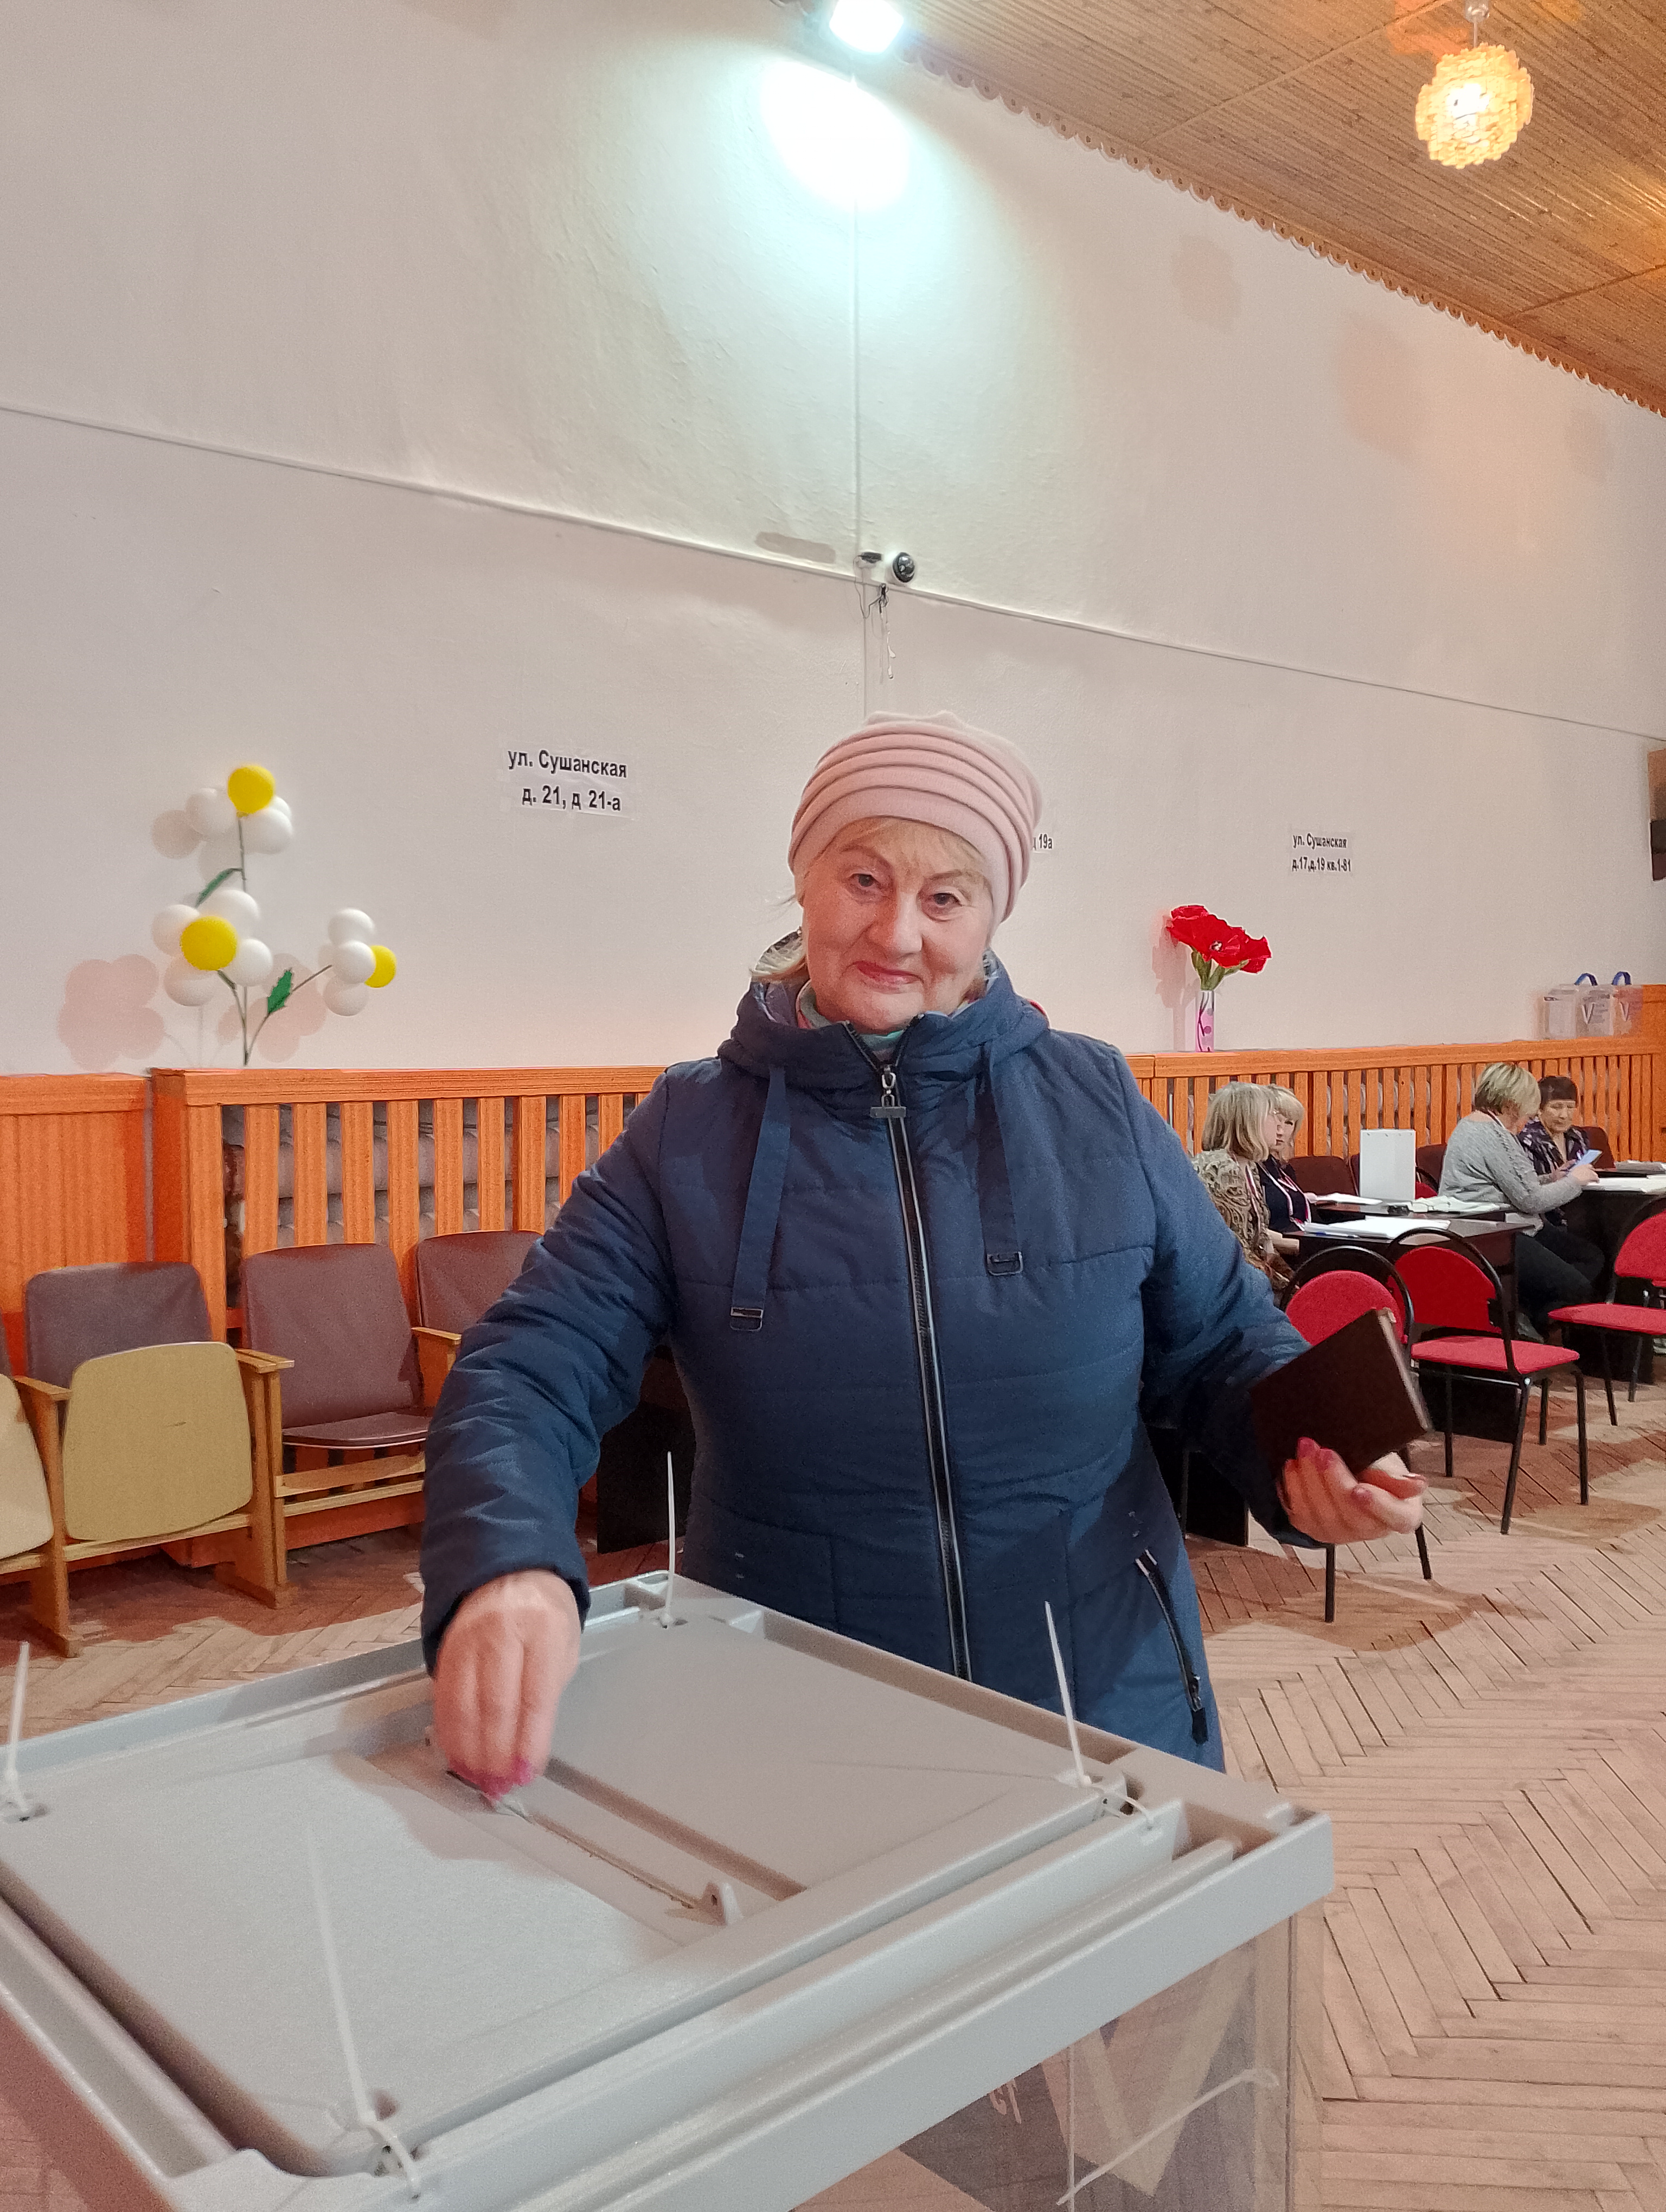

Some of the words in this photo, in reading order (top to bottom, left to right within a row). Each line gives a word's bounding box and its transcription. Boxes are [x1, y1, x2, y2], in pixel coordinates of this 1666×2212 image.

[508, 750, 533, 770] ул.
[539, 750, 627, 778] Сушанская
[522, 788, 536, 806] д.
[542, 785, 566, 809] 21,
[572, 793, 581, 810] д
[588, 790, 621, 811] 21-а
[1039, 833, 1053, 850] 19а
[1293, 835, 1305, 848] ул.
[1307, 833, 1347, 850] Сушанская
